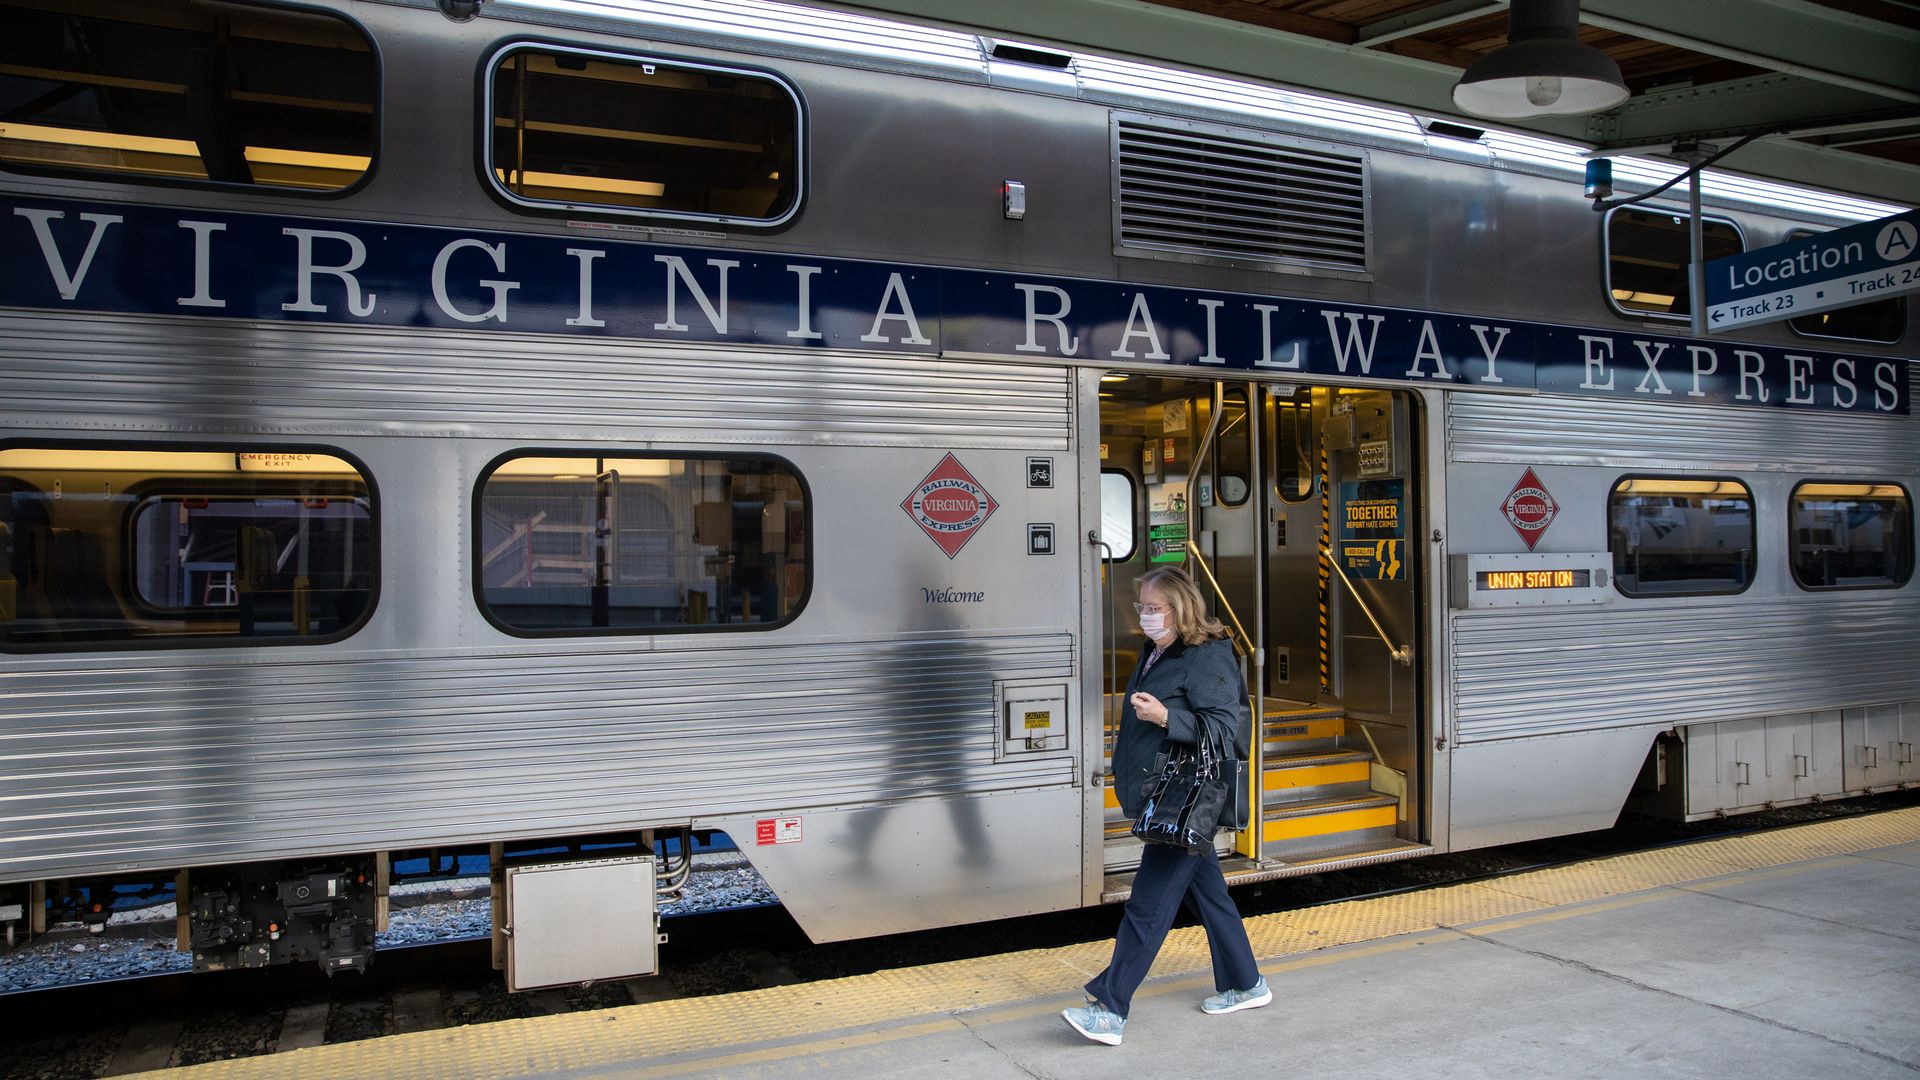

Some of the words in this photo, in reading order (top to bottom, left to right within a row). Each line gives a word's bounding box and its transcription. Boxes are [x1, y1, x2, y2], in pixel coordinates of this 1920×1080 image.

[1729, 241, 1863, 290] Location
[1884, 226, 1911, 255] A
[1848, 272, 1895, 295] Track
[14, 207, 931, 346] VIRGINIA
[1014, 282, 1510, 383] RAILWAY
[1578, 335, 1898, 411] EXPRESS
[1731, 298, 1770, 319] Track
[1775, 295, 1794, 311] 23
[921, 480, 980, 495] RAILWAY
[1513, 489, 1548, 500] RAILWAY
[924, 499, 976, 512] VIRGINIA
[1346, 505, 1398, 520] TOGETHER
[1514, 504, 1546, 514] VIRGINIA
[920, 516, 980, 531] EXPRESS
[1346, 521, 1365, 529] REPORT
[1379, 520, 1399, 528] CRIMES
[1488, 573, 1523, 589] UNION
[1526, 571, 1573, 588] STATION
[920, 587, 984, 604] Welcome
